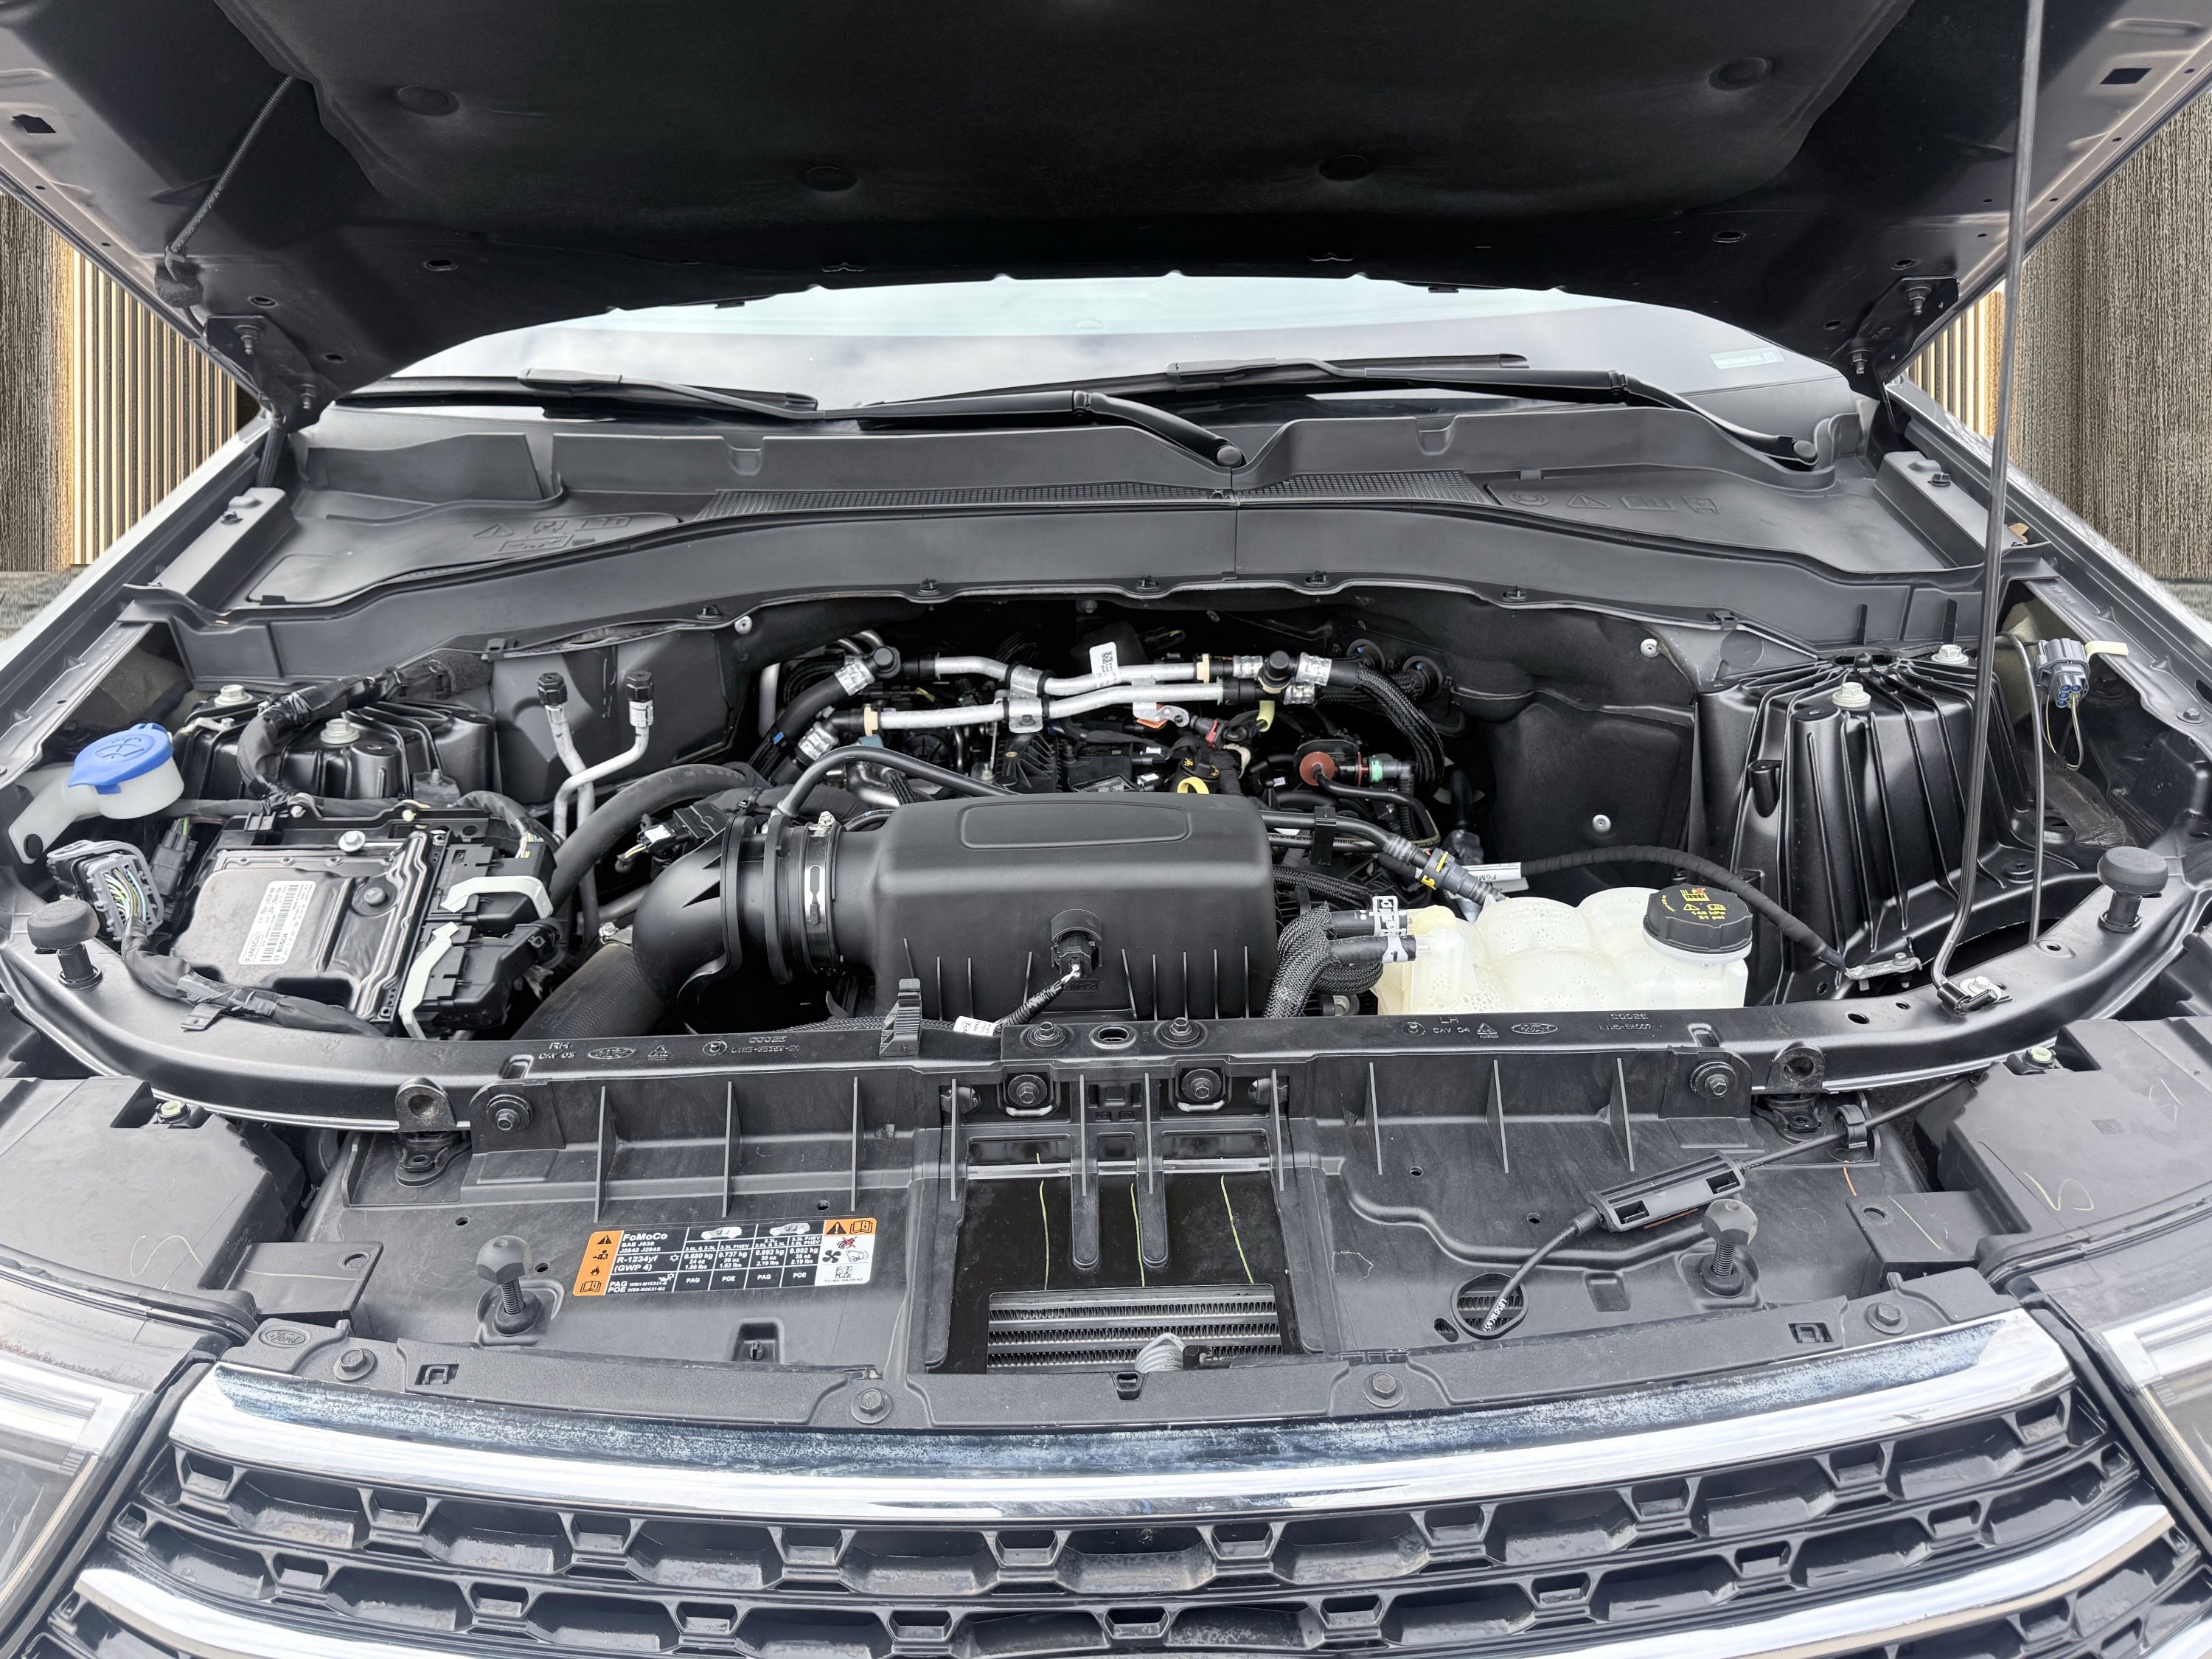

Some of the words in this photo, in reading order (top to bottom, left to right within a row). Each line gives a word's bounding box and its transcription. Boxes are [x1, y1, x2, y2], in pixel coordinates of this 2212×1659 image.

[276, 933, 288, 953] BOSCH
[245, 936, 260, 961] FoMoCo
[1062, 982, 1096, 990] oMoCo
[549, 1042, 571, 1050] RH
[622, 1232, 668, 1241] FoMoCo
[616, 1255, 658, 1263] R-1234yf
[613, 1264, 641, 1273] (GWP
[642, 1263, 652, 1272] 4)
[270, 1331, 300, 1343] Ford
